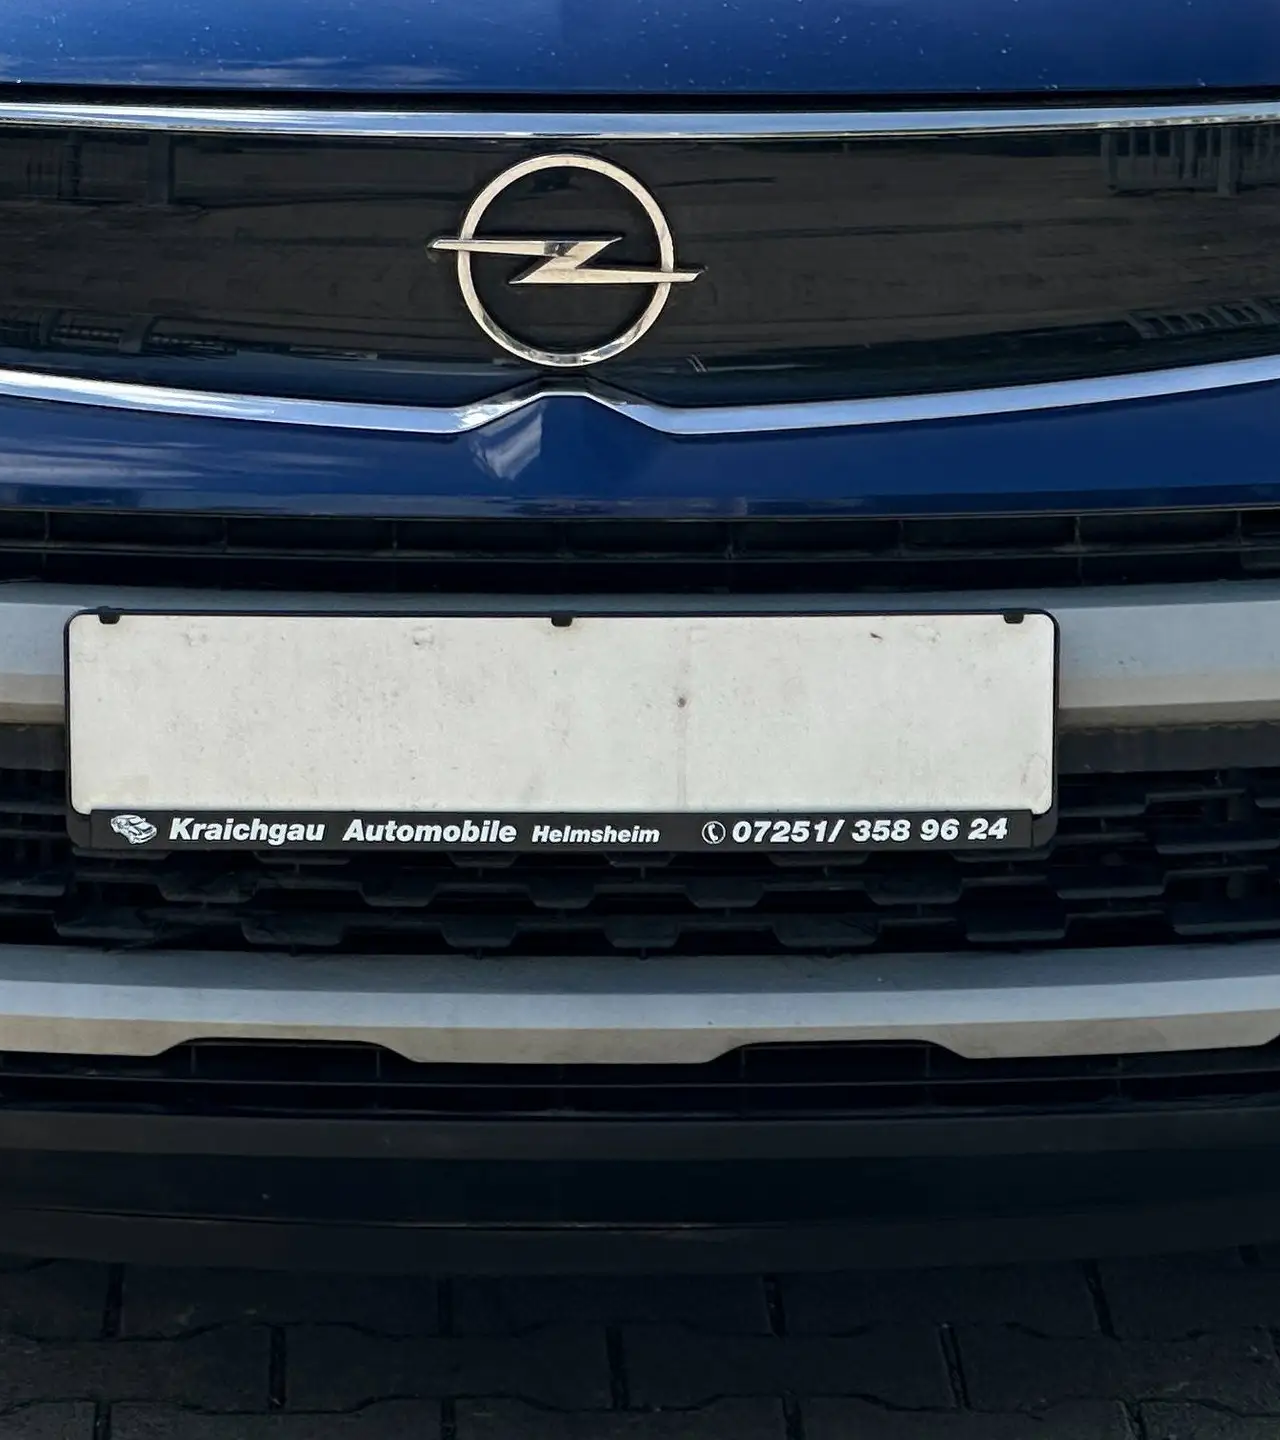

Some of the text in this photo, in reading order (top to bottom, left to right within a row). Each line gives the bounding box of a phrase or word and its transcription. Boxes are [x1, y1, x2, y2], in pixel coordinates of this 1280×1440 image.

[169, 816, 1009, 846] Kraichgau Automobile Helmsheim 07251/ 358 96 24
